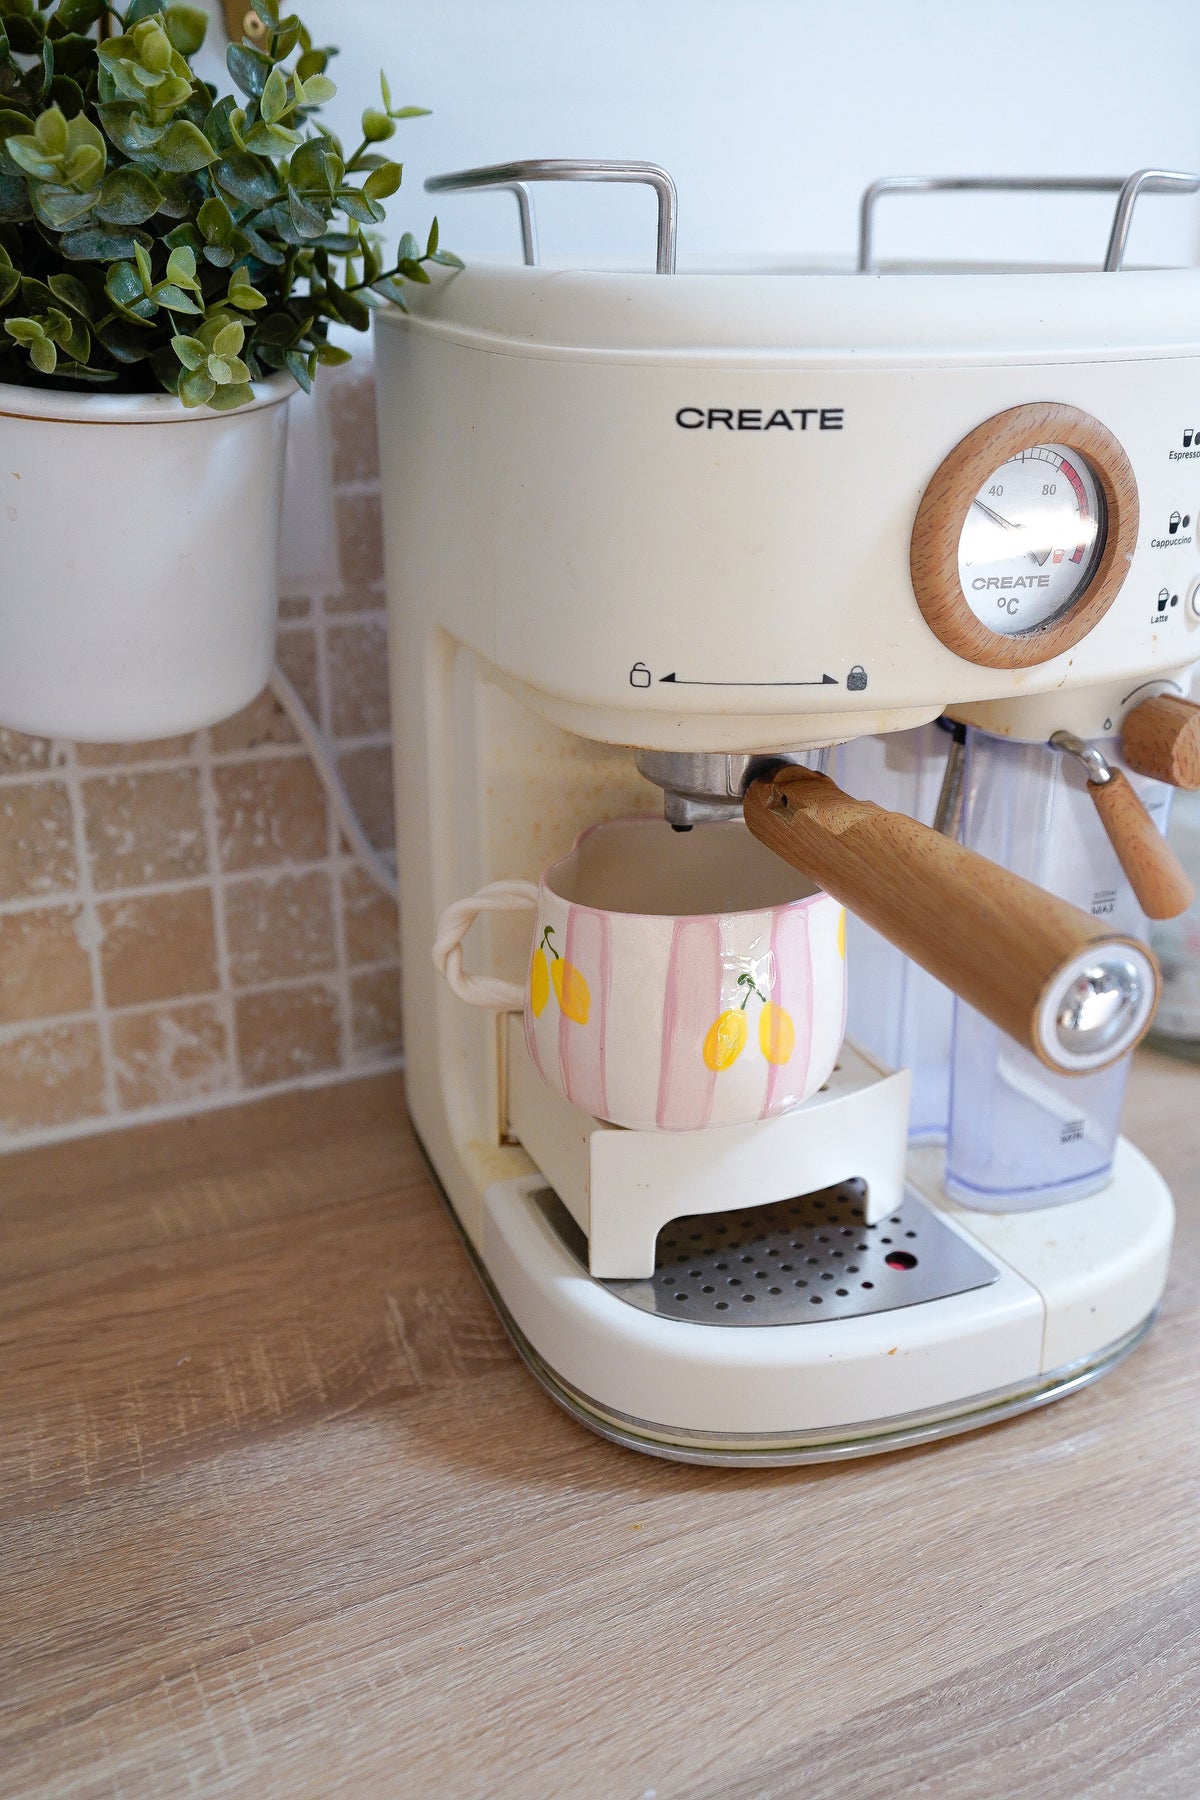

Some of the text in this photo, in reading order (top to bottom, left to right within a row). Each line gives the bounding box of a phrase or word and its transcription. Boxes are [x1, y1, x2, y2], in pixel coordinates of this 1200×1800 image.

[676, 407, 844, 430] CREATE
[1168, 450, 1200, 462] Espresso
[988, 484, 1004, 497] 40
[1041, 484, 1057, 496] 80
[1150, 536, 1192, 549] Cappuccino
[971, 575, 1051, 591] CREATE
[997, 597, 1020, 615] °C
[1150, 614, 1168, 624] Latte
